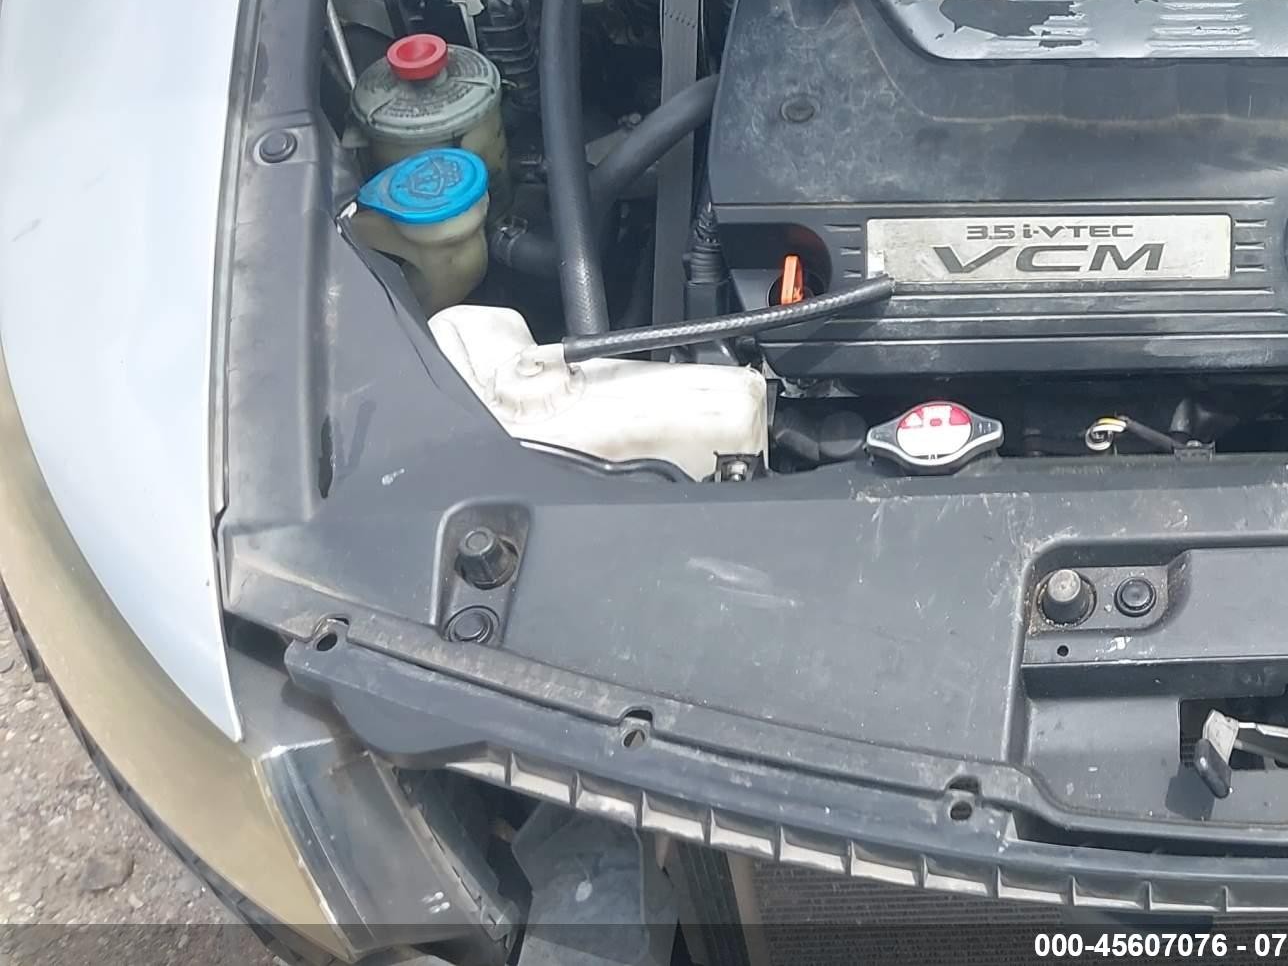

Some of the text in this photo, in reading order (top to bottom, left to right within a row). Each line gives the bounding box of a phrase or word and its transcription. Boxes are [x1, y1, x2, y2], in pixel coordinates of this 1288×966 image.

[966, 223, 1134, 240] 3.5 i-VTEC
[932, 242, 1166, 274] VCM
